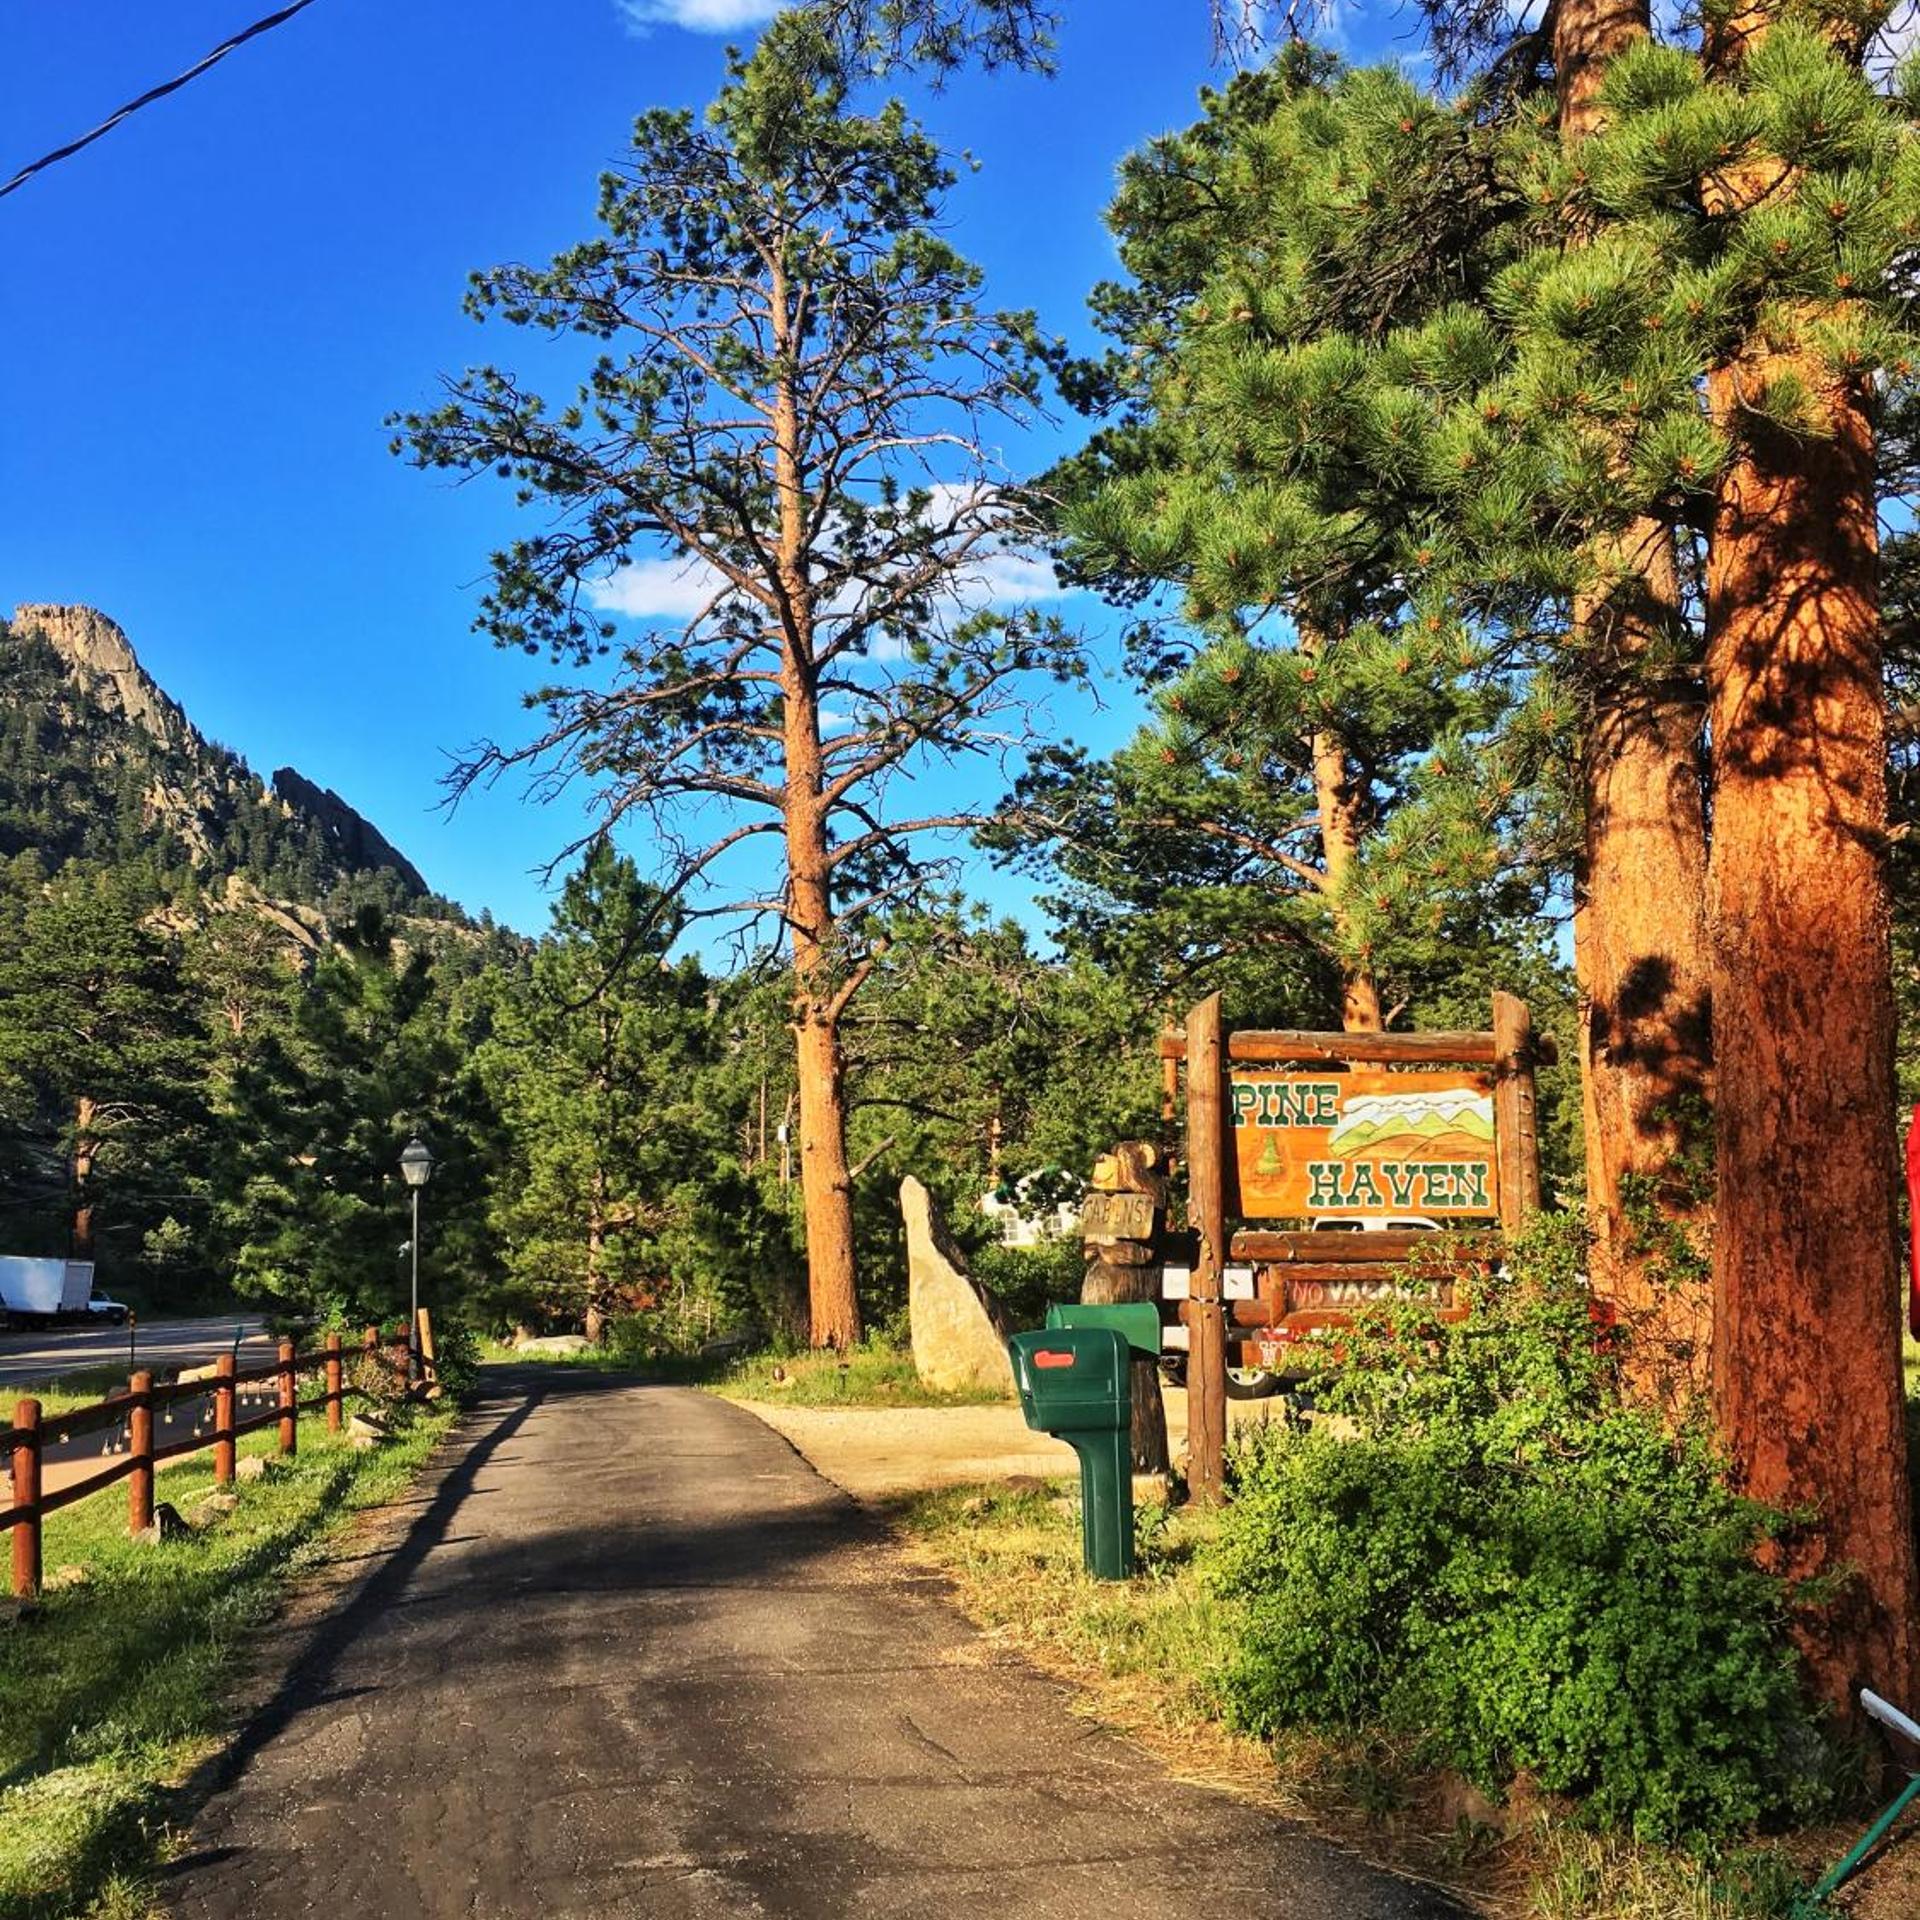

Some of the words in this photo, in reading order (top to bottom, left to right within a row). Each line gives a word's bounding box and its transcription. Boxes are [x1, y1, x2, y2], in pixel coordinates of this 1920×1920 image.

[1230, 1083, 1340, 1127] PINE
[1308, 1162, 1490, 1209] HAVEN
[1293, 1281, 1323, 1303] NO
